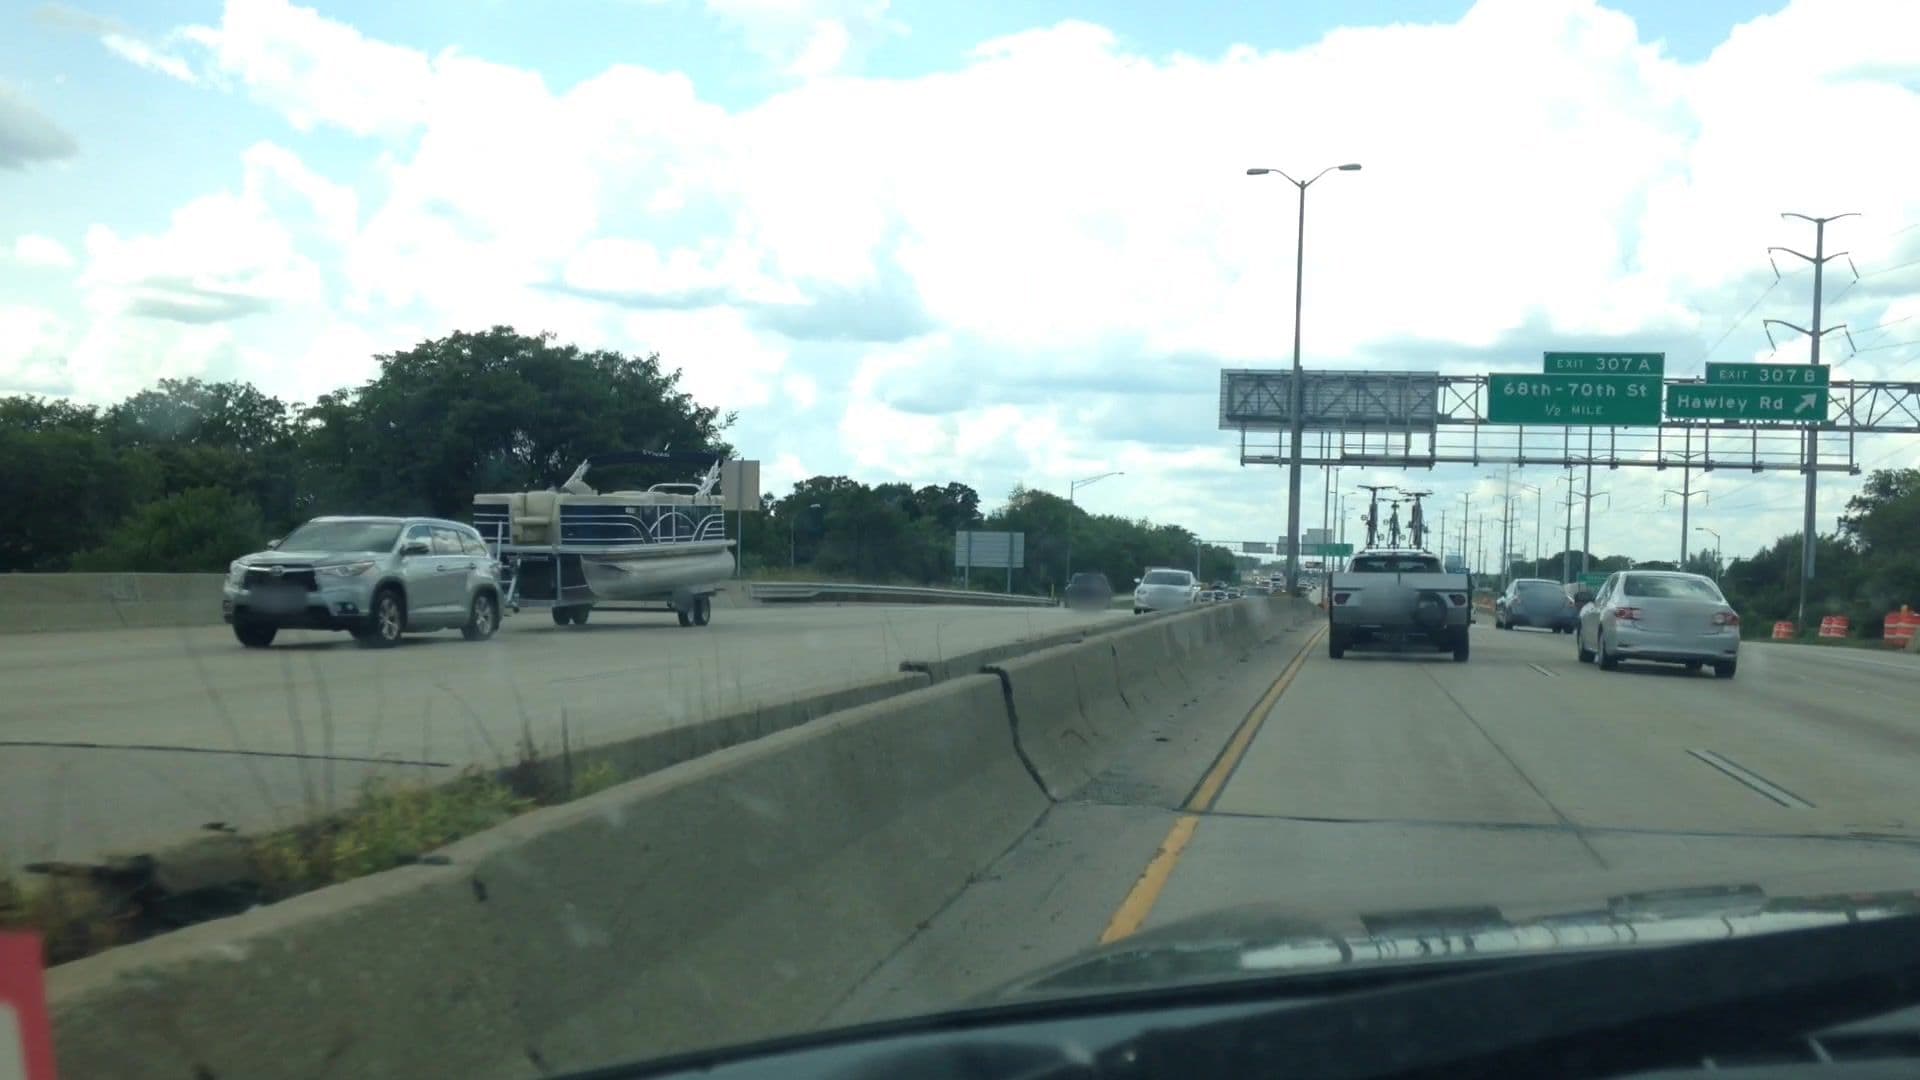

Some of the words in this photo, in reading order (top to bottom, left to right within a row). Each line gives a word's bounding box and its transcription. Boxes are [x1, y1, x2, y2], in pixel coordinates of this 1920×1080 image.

[1557, 359, 1585, 368] EXIT
[1596, 358, 1632, 370] 307
[1639, 359, 1650, 370] A
[1719, 370, 1748, 379] EXIT
[1760, 369, 1796, 382] 307
[1805, 371, 1815, 382] B
[1626, 384, 1647, 396] St
[1678, 394, 1747, 411] Hawley
[1760, 397, 1784, 409] Rd
[1571, 406, 1603, 415] MILE
